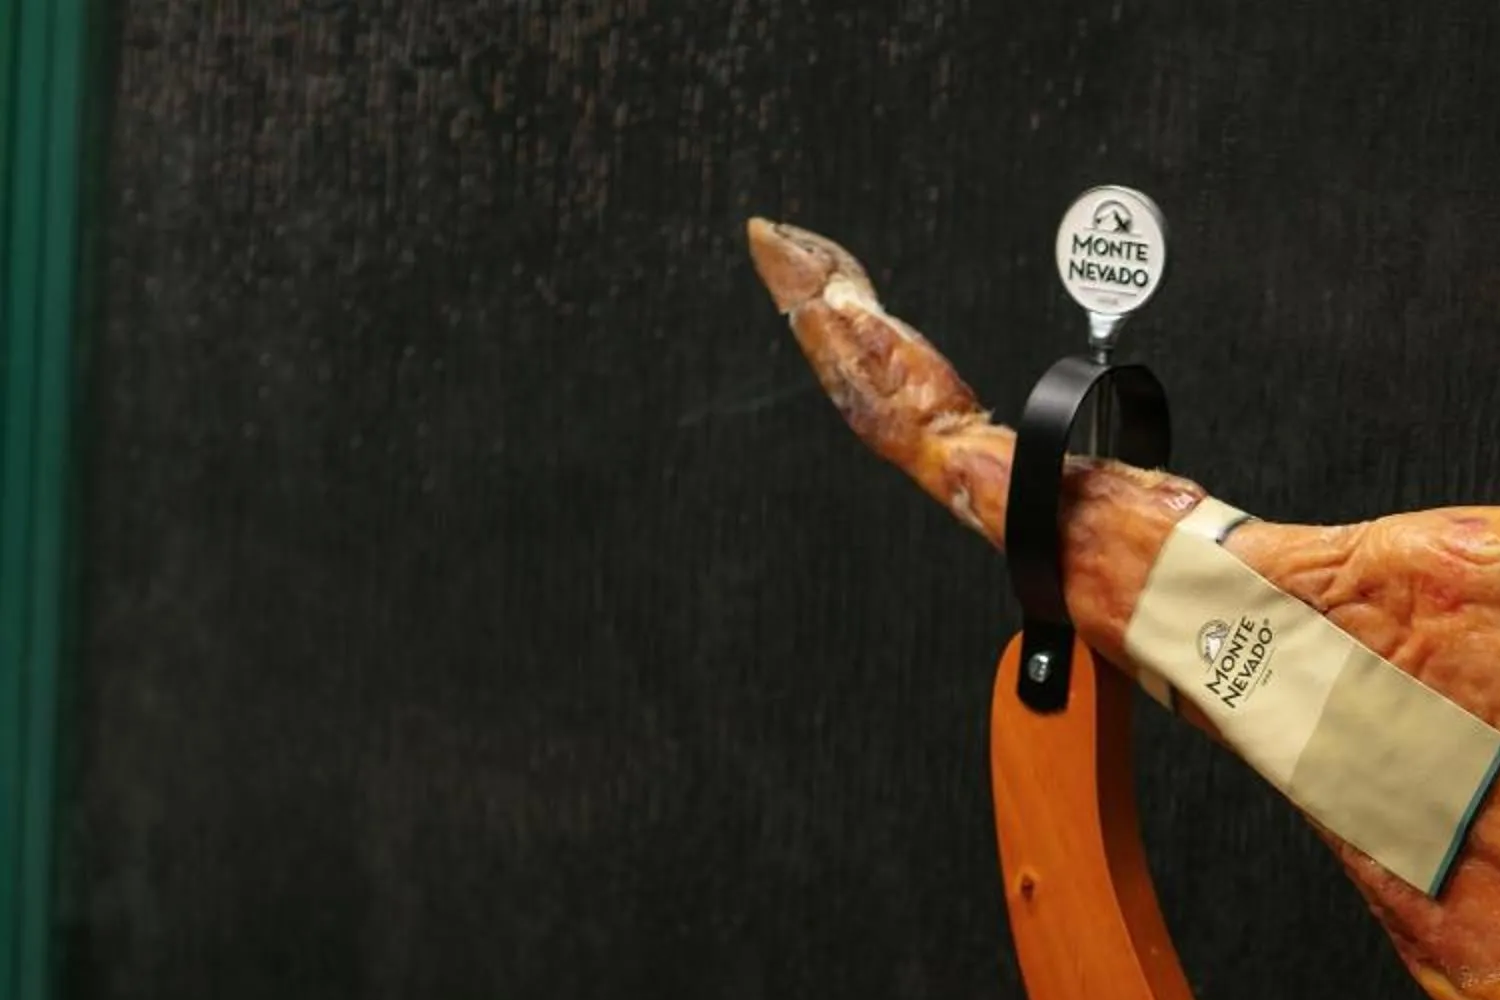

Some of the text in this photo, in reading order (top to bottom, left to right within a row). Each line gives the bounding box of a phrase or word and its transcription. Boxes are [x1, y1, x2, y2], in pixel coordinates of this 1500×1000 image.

[1069, 259, 1148, 287] NEVADO
[1071, 233, 1149, 262] MONTE
[1206, 616, 1255, 694] MONTE
[1221, 626, 1273, 708] NEVADO
